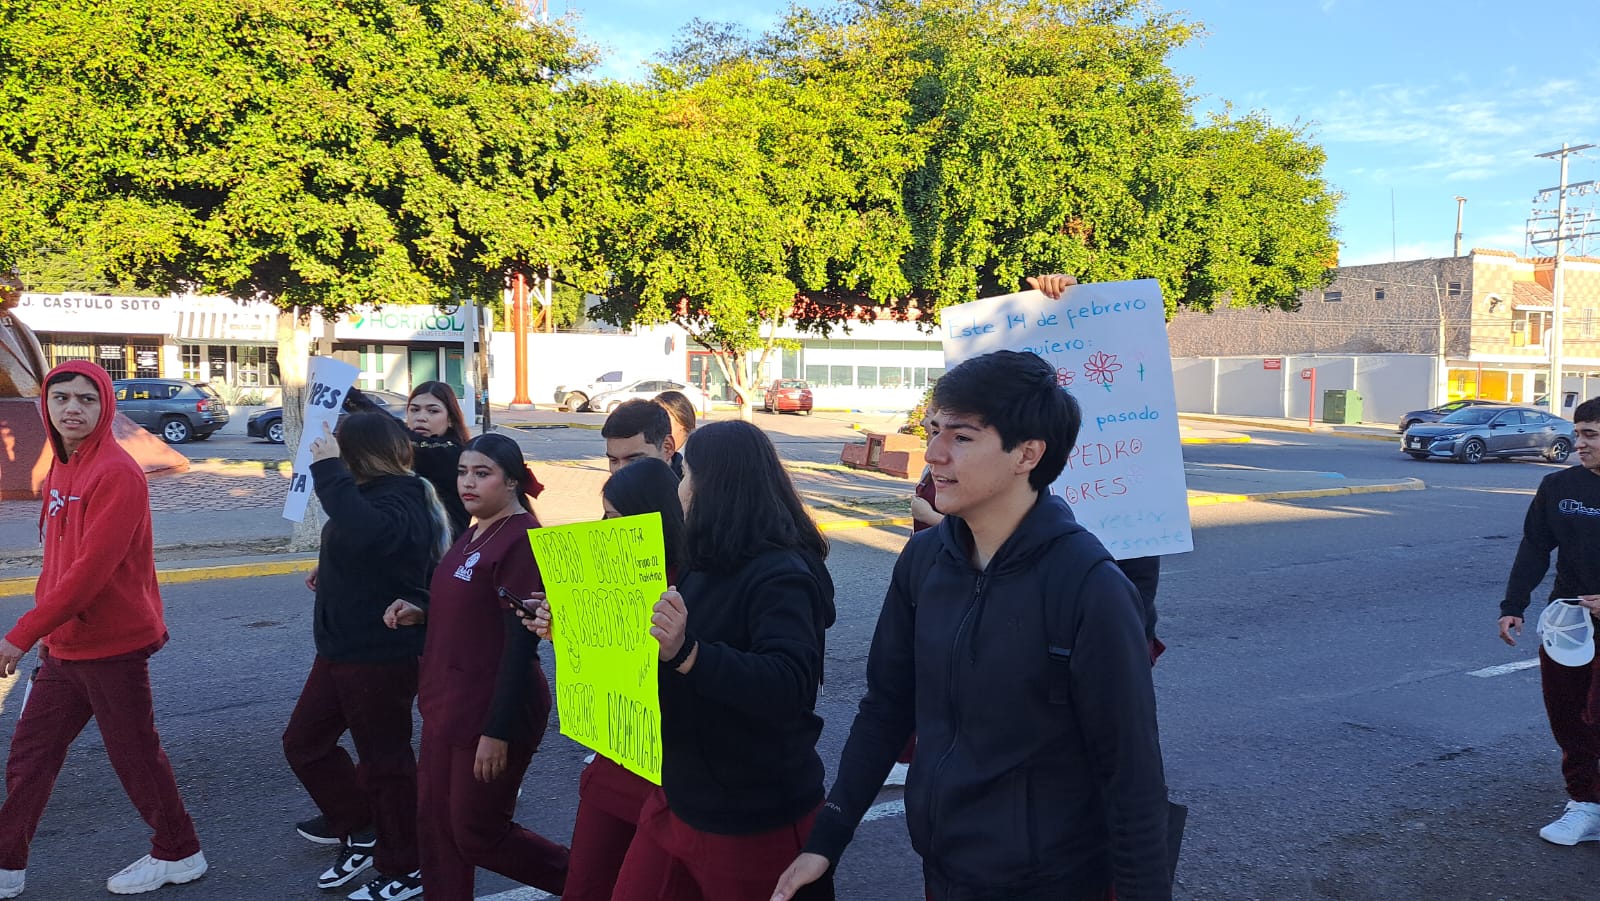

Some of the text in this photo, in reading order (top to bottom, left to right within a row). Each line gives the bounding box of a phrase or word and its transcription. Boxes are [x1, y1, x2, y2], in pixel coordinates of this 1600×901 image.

[22, 297, 161, 310] J. CASTULO SOTO
[948, 298, 1147, 339] Este 14 de febrero
[1096, 405, 1160, 431] pasado
[1067, 438, 1143, 470] PEDRO
[588, 527, 636, 586] COMO
